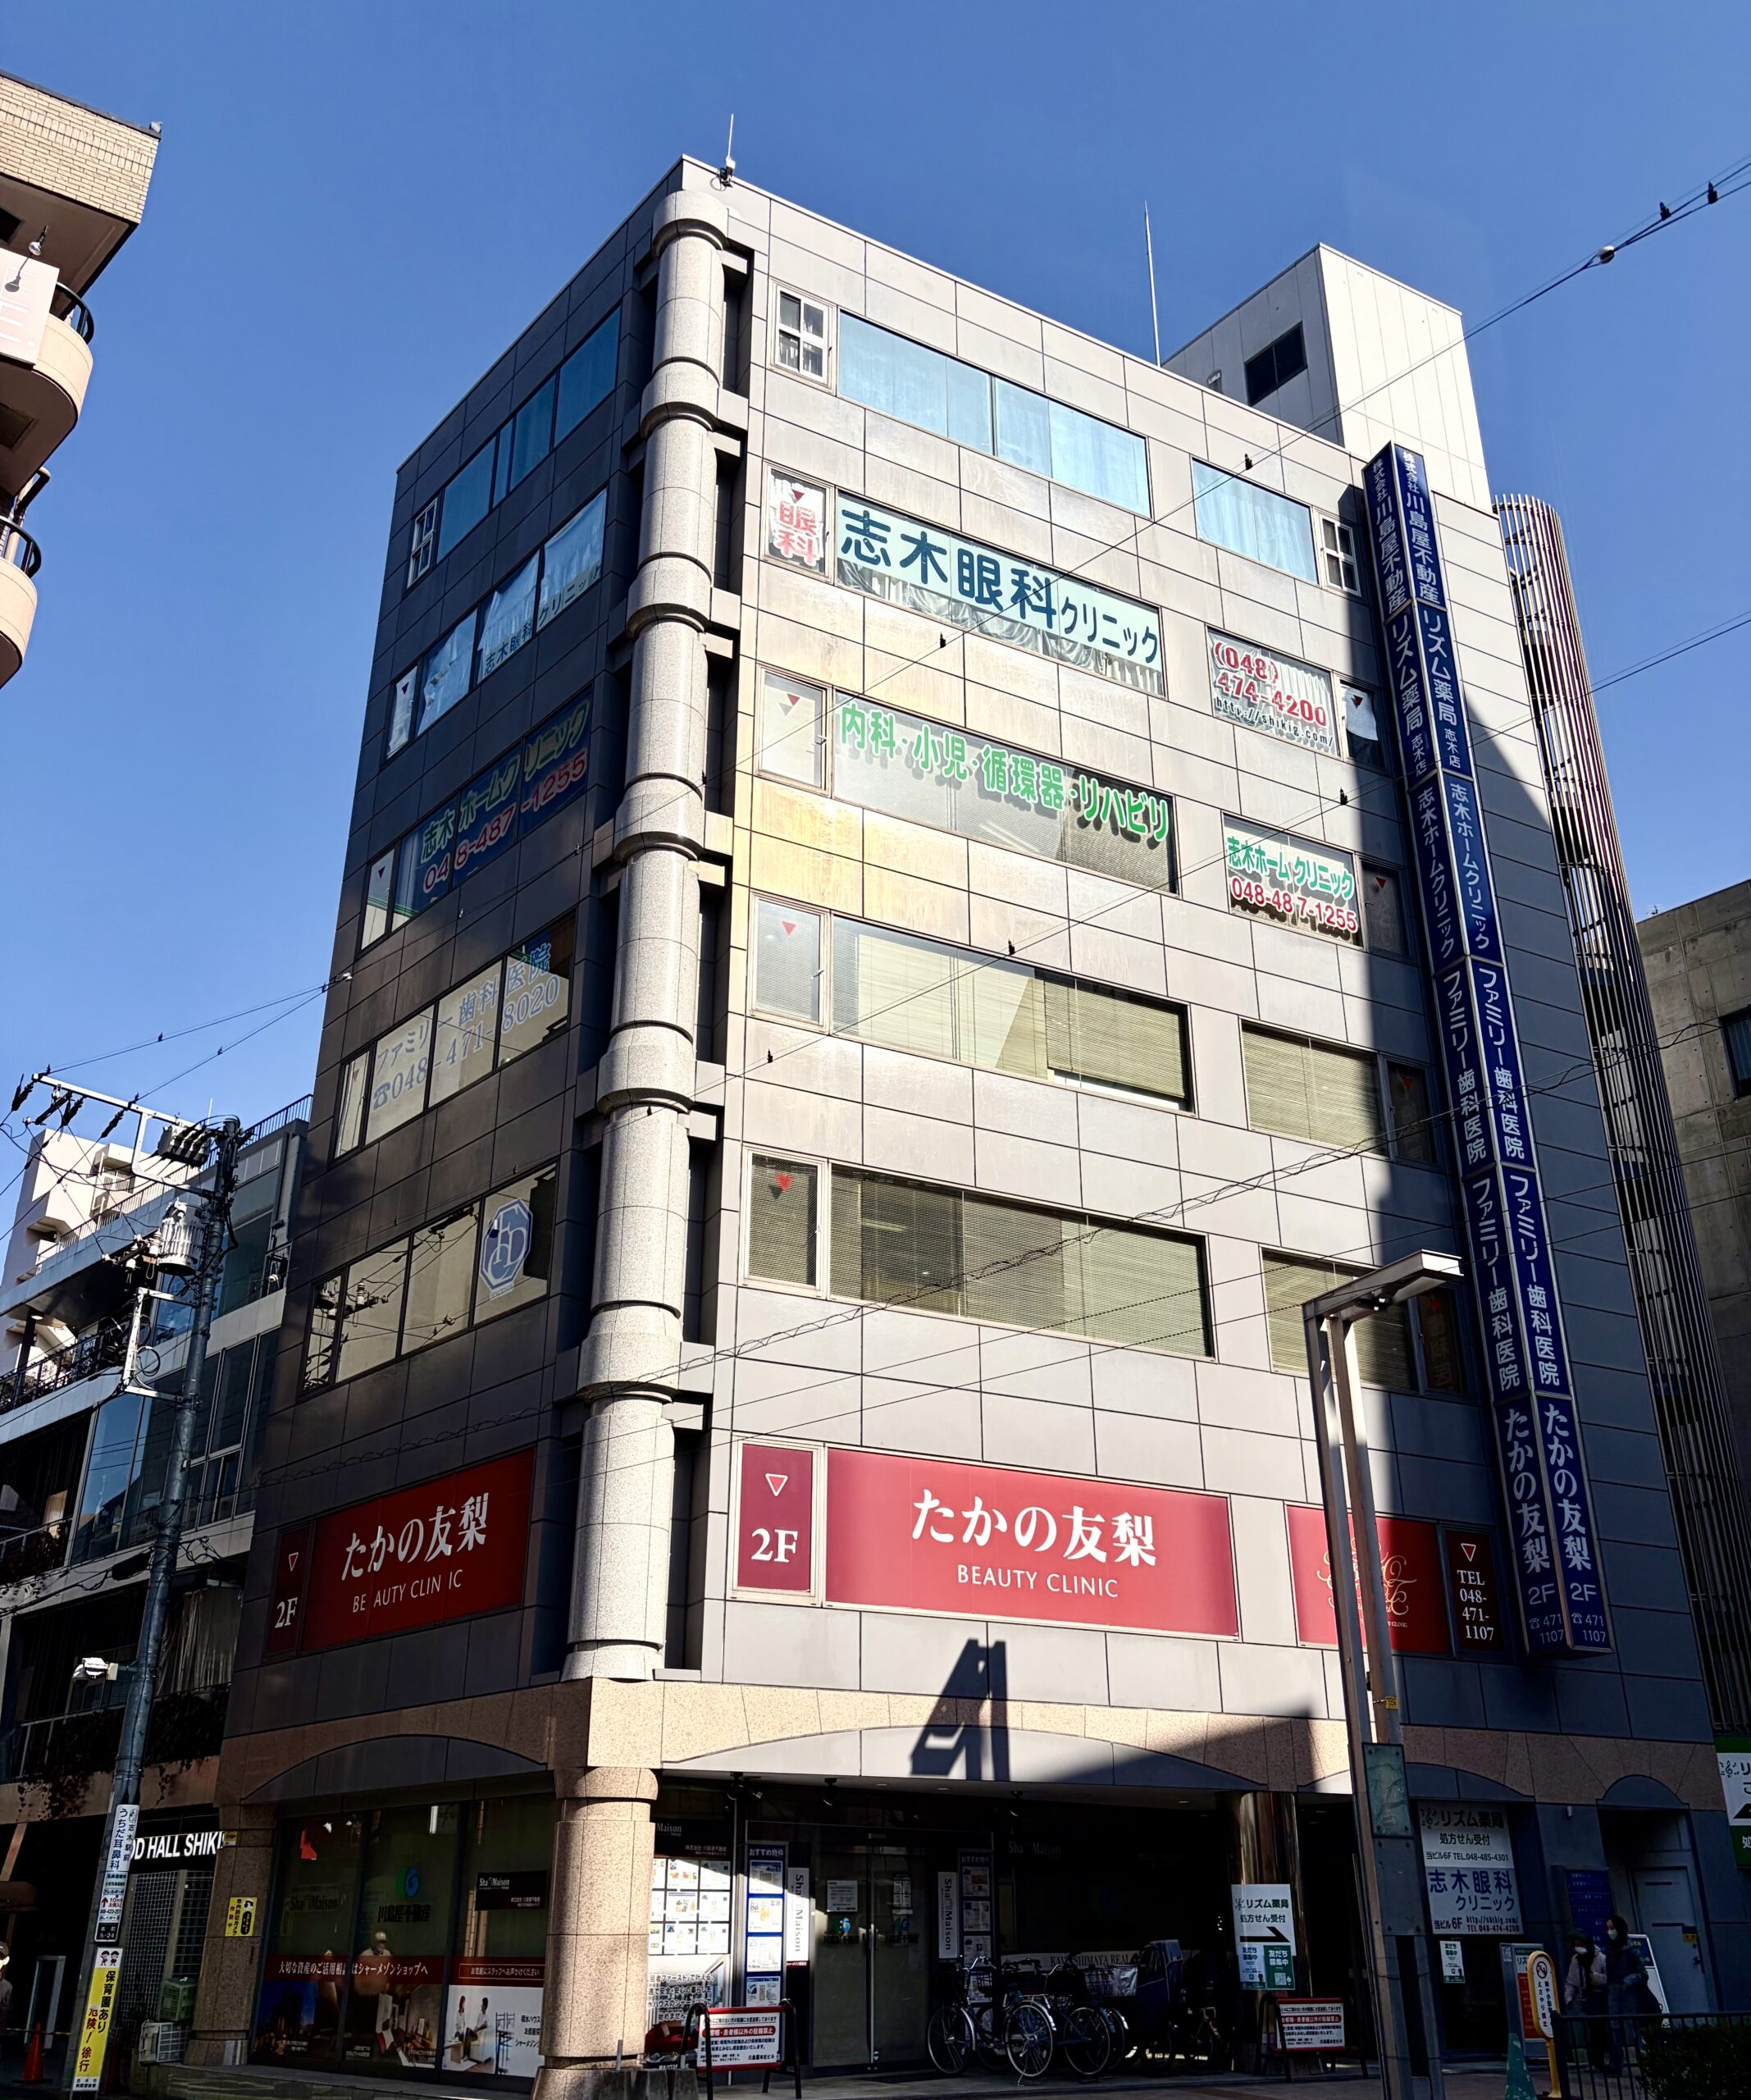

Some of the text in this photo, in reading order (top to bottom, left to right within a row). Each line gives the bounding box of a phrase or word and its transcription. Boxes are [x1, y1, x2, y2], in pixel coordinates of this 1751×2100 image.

[775, 500, 817, 567] 眼科
[841, 509, 1159, 664] 志木眼科クリニック
[1215, 642, 1279, 683] (048)
[1392, 614, 1424, 736] リズム薬局
[1424, 609, 1457, 726] リズム薬局
[1218, 672, 1326, 727] 474-4200
[1215, 697, 1334, 747] http://shikig.com/
[1417, 787, 1455, 958] 志木ホームクリニック
[1450, 782, 1490, 949] 志木ホームクリニック
[1443, 970, 1486, 1165] ファミリー歯科医院
[1479, 968, 1525, 1160] ファミリー歯科医院
[1472, 1178, 1520, 1391] ファミリー歯科医院
[1510, 1175, 1560, 1386] ファミリー歯科医院
[1504, 1408, 1551, 1574] たかの友梨
[1544, 1403, 1592, 1571] たかの友梨
[341, 1492, 490, 1581] たかの友梨
[750, 1528, 799, 1564] 2F
[912, 1489, 1157, 1567] たかの友梨
[957, 1564, 1119, 1597] BEAUTY CLINIC
[1457, 1570, 1485, 1586] TEL
[1460, 1588, 1487, 1603] 048-
[1528, 1583, 1555, 1605] 2F
[1570, 1582, 1597, 1601] 2F
[275, 1597, 298, 1628] 2F
[1461, 1607, 1489, 1622] 471-
[1585, 1614, 1604, 1628] 471
[1465, 1625, 1493, 1641] 1107
[1540, 1628, 1564, 1645] 1107
[1582, 1629, 1606, 1642] 1107
[110, 1809, 127, 1869] うちだ耳鼻科
[1440, 1833, 1490, 1846] 処方せん受付
[1441, 1810, 1504, 1829] リズム薬局
[147, 1835, 180, 1859] HALL
[1428, 1869, 1512, 1895] 志木眼科
[1240, 1914, 1286, 1923] 処方せん受付
[1246, 1899, 1289, 1909] リズム薬局
[1456, 1895, 1514, 1912] クリニック
[945, 1911, 953, 1951] Maison
[98, 1970, 116, 2034] 保育園あり
